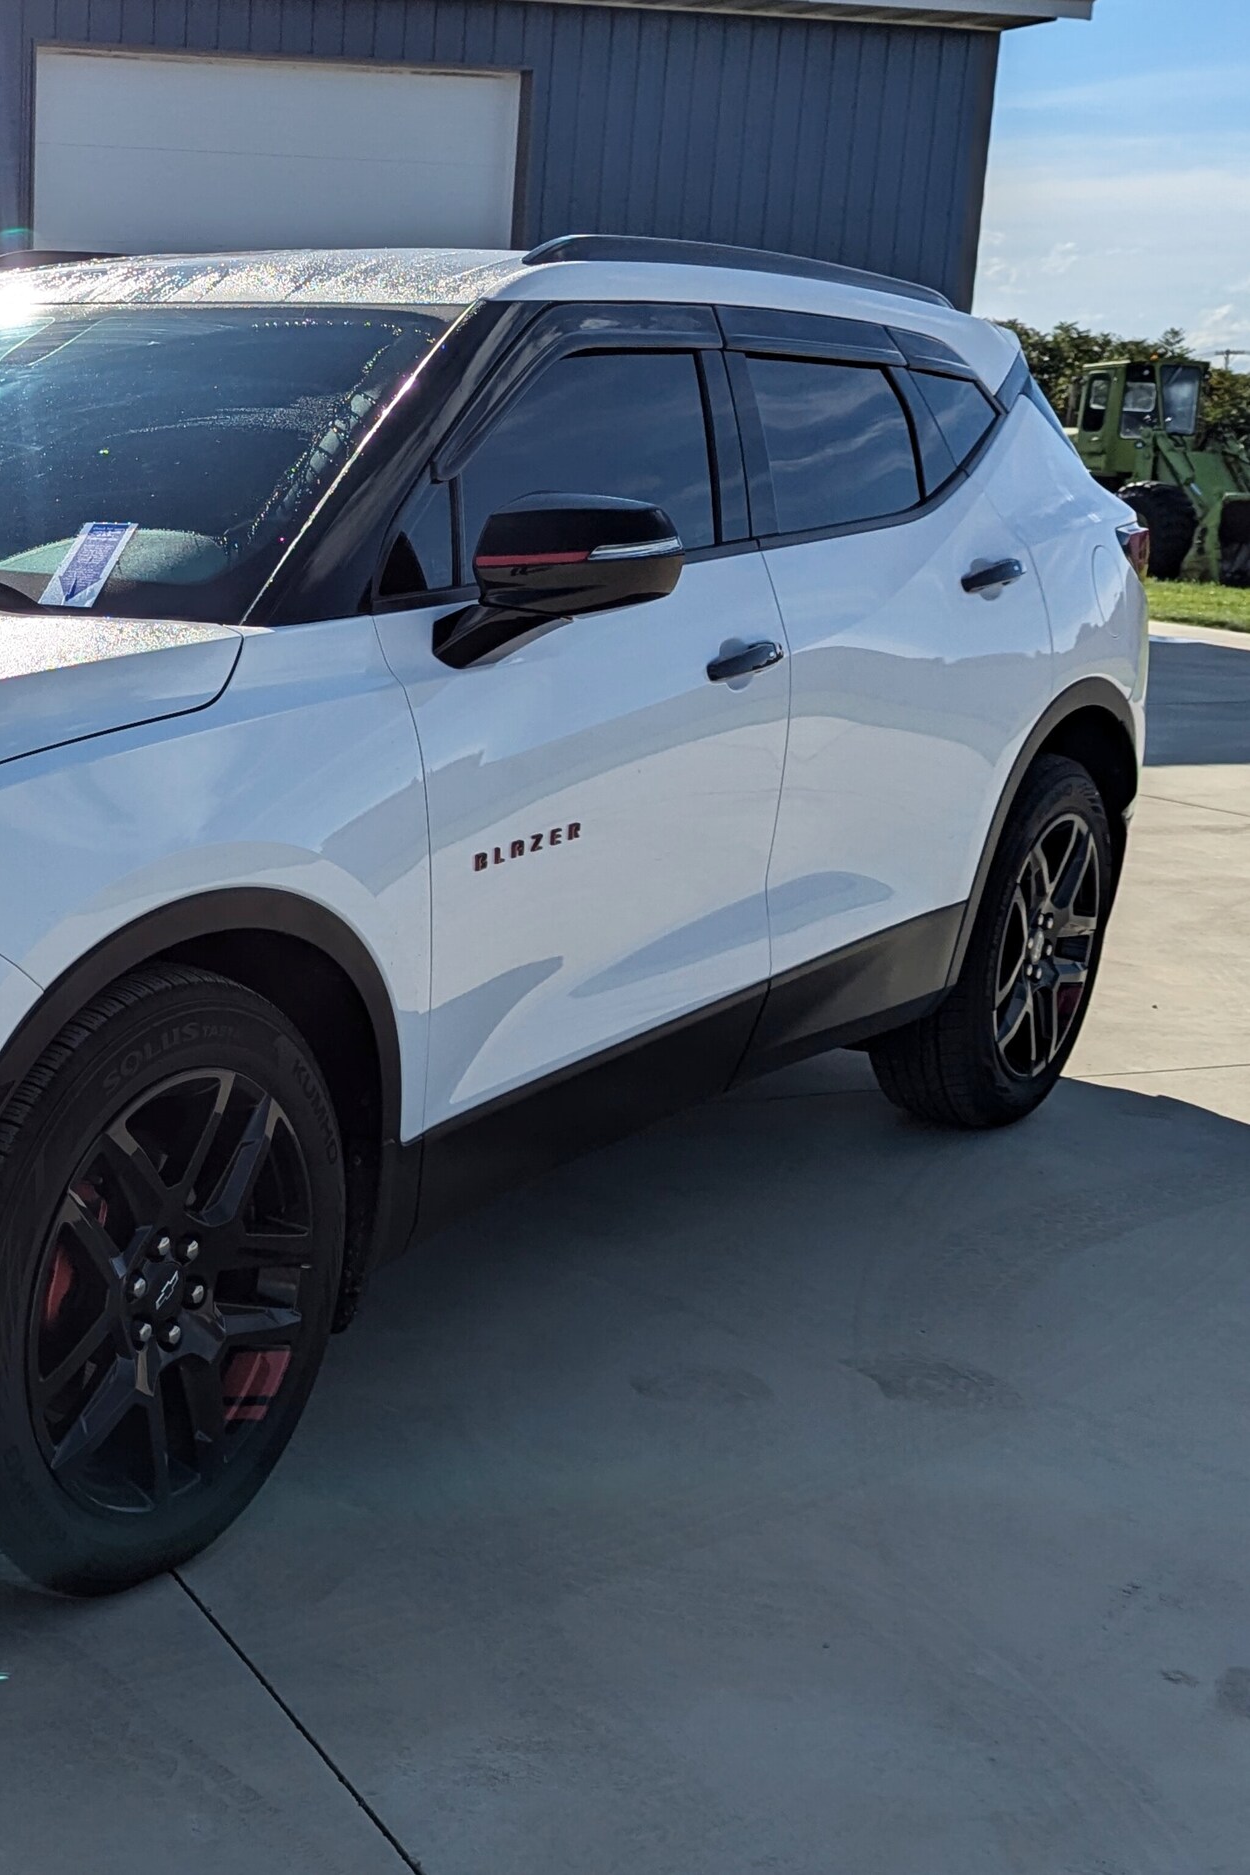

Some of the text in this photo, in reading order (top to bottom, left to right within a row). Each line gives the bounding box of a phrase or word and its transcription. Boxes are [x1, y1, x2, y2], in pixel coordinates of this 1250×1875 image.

[474, 822, 581, 872] BLAZER
[103, 1022, 199, 1095] SOLUS
[294, 1059, 337, 1164] KUMHO
